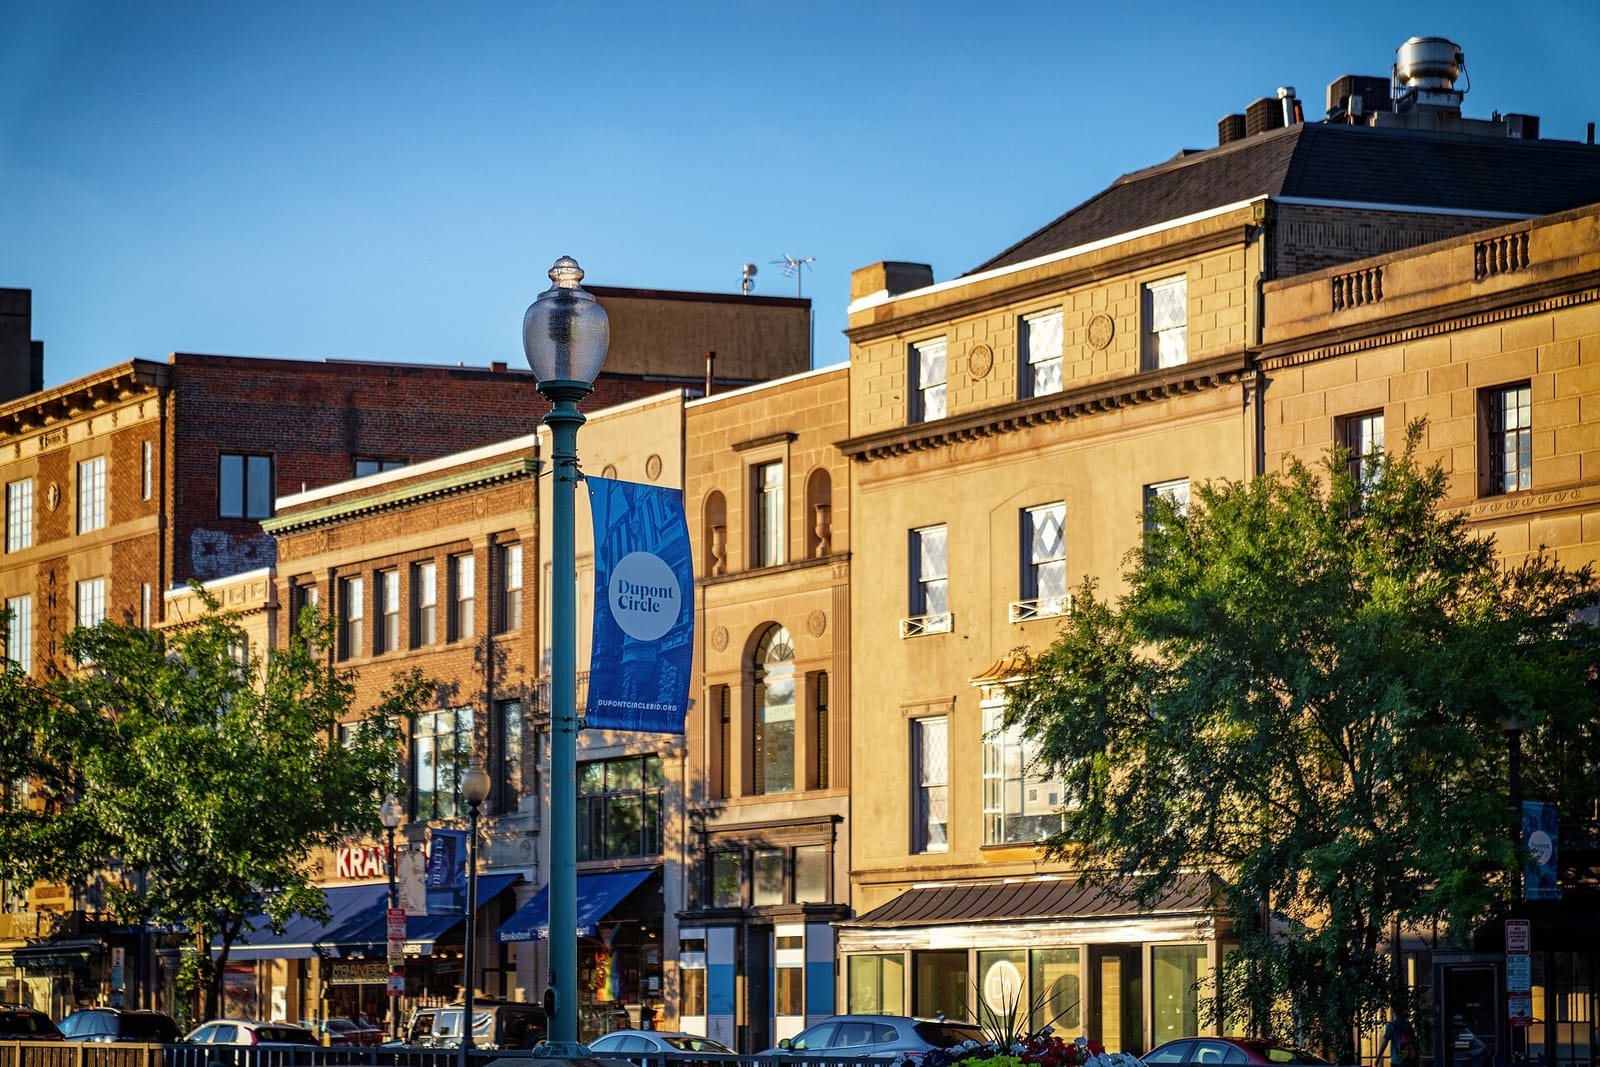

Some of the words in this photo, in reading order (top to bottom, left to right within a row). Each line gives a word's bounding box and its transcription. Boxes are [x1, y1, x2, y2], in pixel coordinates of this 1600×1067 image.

[617, 580, 674, 600] Dupont
[617, 595, 660, 613] Circle
[47, 567, 57, 679] ANCHO
[597, 699, 678, 712] DUPONTCIRCLEBID.ORG
[500, 929, 532, 942] Bookstore
